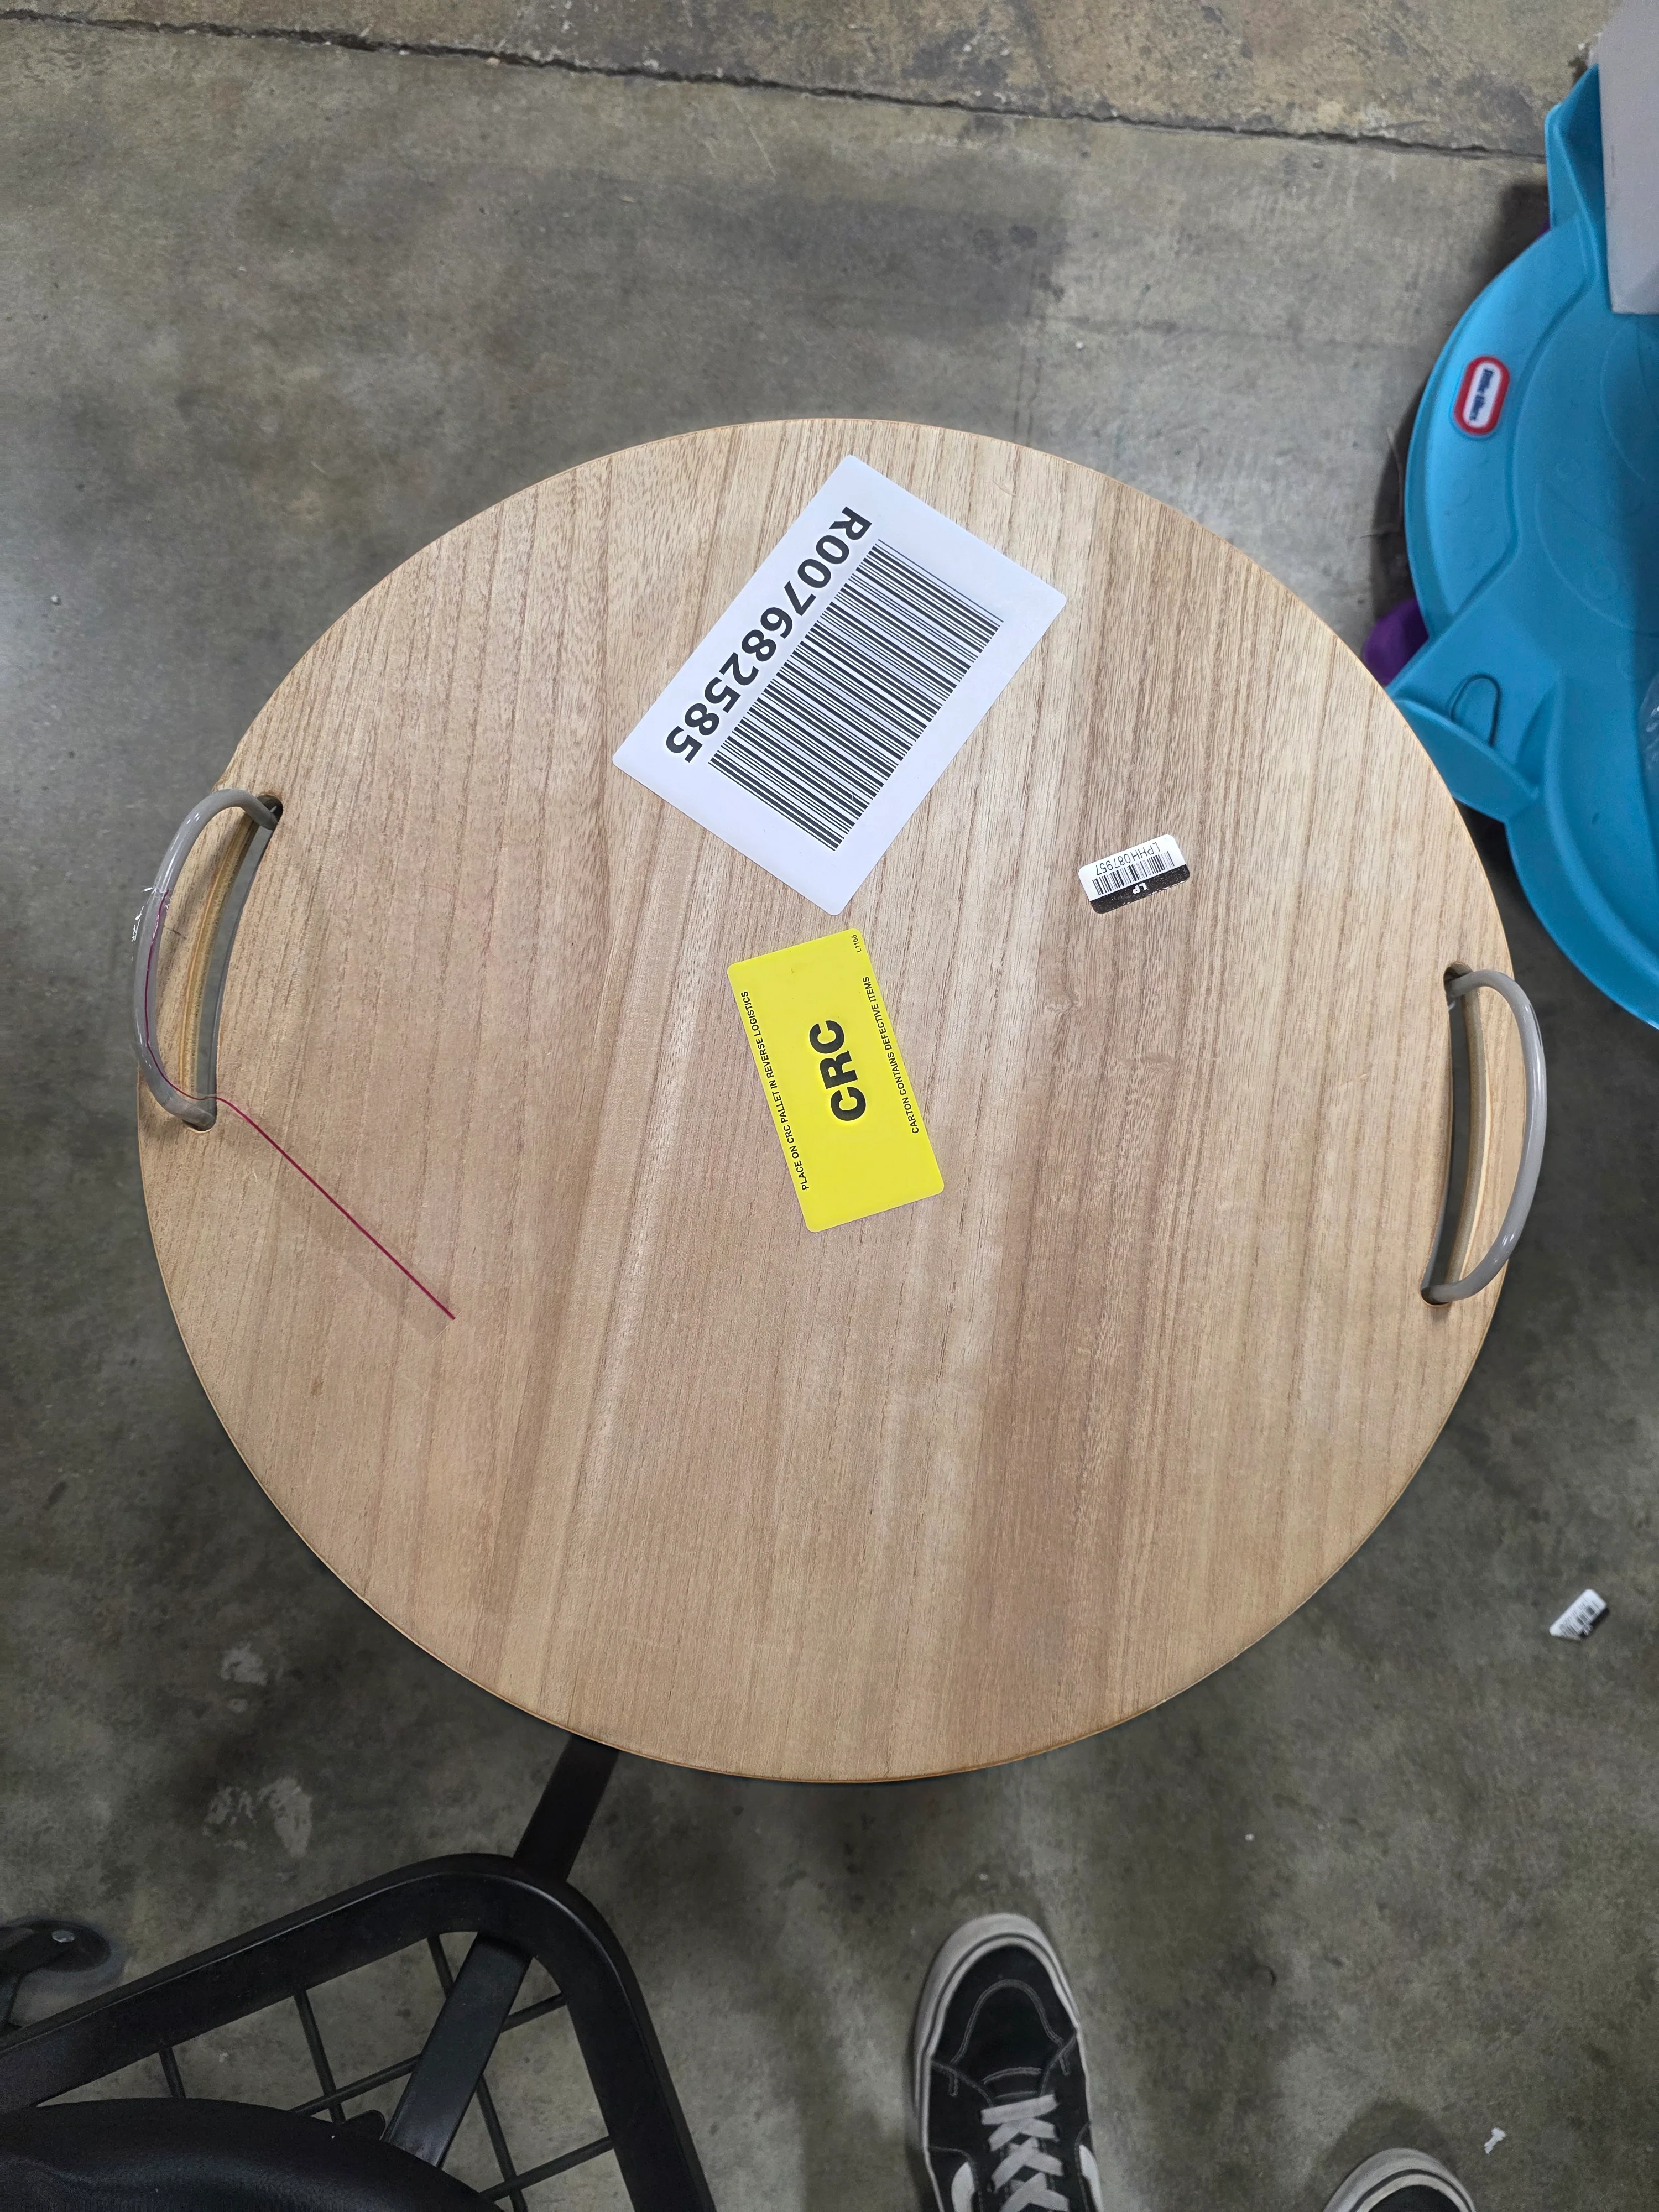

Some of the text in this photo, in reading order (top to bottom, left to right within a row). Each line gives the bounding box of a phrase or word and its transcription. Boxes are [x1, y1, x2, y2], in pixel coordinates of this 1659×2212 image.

[666, 507, 872, 763] R007682585
[851, 934, 862, 953] L1166
[1133, 883, 1147, 894] LP
[740, 991, 809, 1191] PLACE ON CRC PALLET IN REVERSE LOGISTICS
[809, 1020, 867, 1121] CRC
[862, 976, 919, 1133] CARTON CONTAINS DEFECTIVE ITEMS
